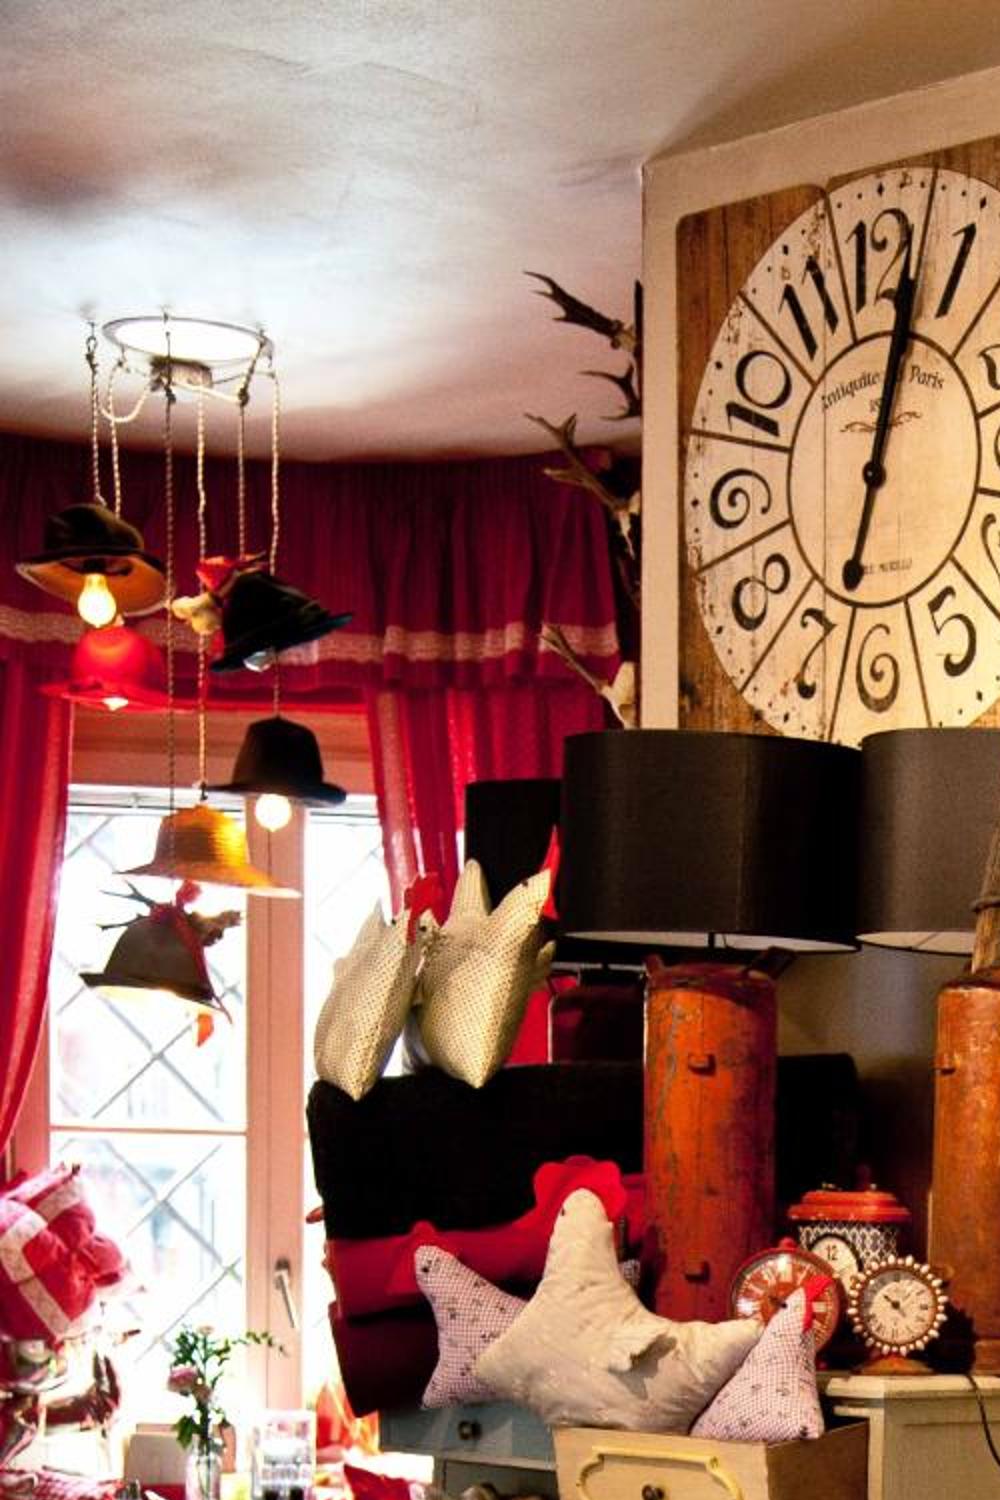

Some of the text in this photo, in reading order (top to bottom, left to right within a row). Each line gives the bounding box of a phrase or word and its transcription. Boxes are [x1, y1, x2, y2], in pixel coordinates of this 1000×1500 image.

[845, 208, 914, 314] 12
[935, 223, 976, 319] 1
[778, 255, 839, 361] 11
[726, 350, 792, 437] 10
[908, 364, 945, 390] Paris
[709, 468, 772, 530] 9
[732, 553, 791, 631] 8
[928, 586, 977, 678] 5
[797, 607, 838, 699] 7
[855, 623, 900, 713] 6
